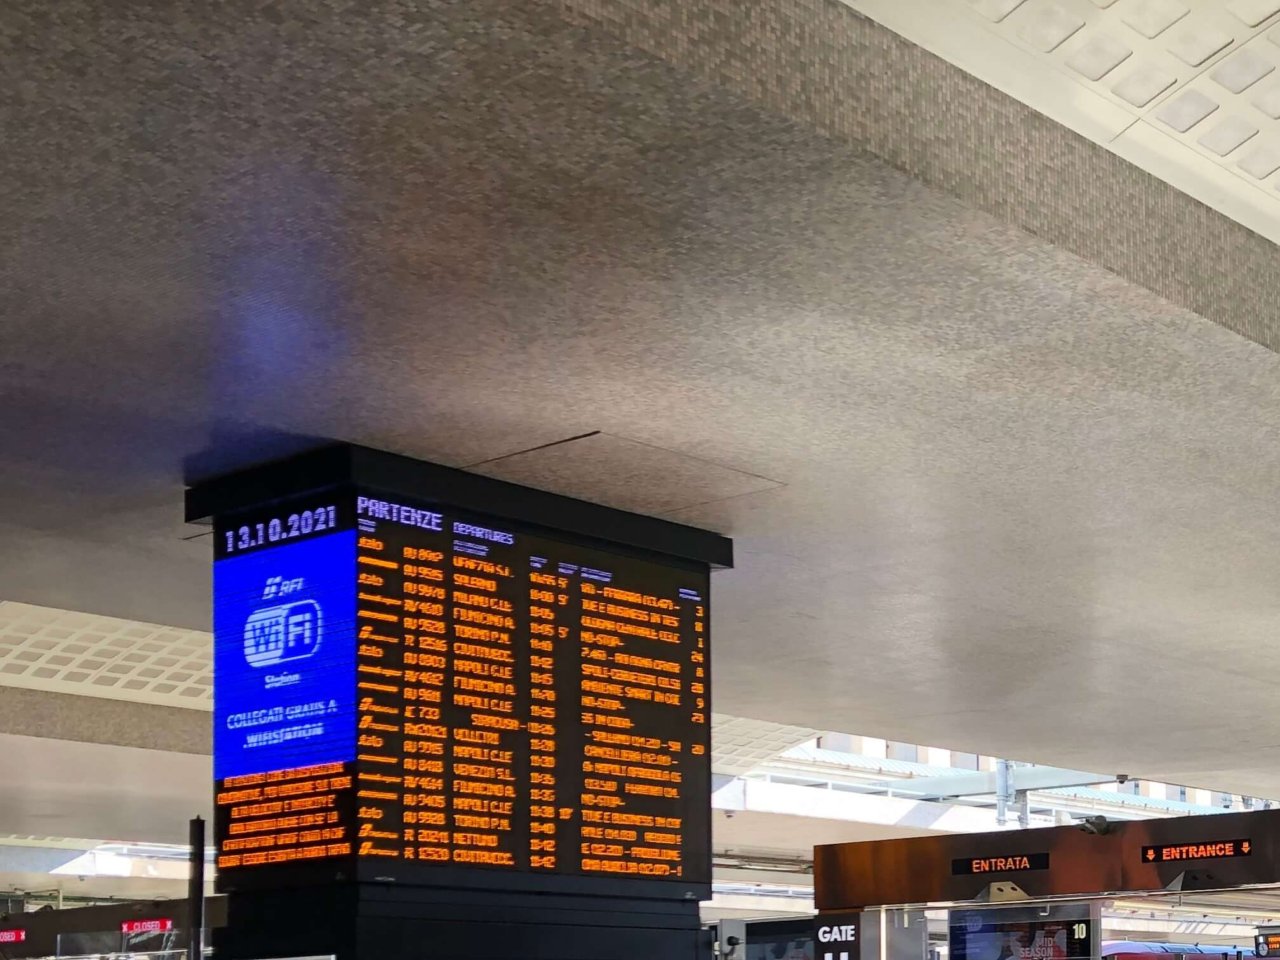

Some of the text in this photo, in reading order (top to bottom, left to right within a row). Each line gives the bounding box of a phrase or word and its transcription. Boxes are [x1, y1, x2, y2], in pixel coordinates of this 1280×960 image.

[357, 496, 444, 531] PARTENZE
[453, 522, 514, 545] DEPARTURES
[1162, 843, 1234, 860] ENTRANCE
[972, 856, 1030, 873] ENTRATA
[133, 920, 161, 931] CLOSED
[818, 925, 855, 943] GATE
[1073, 923, 1087, 940] 10
